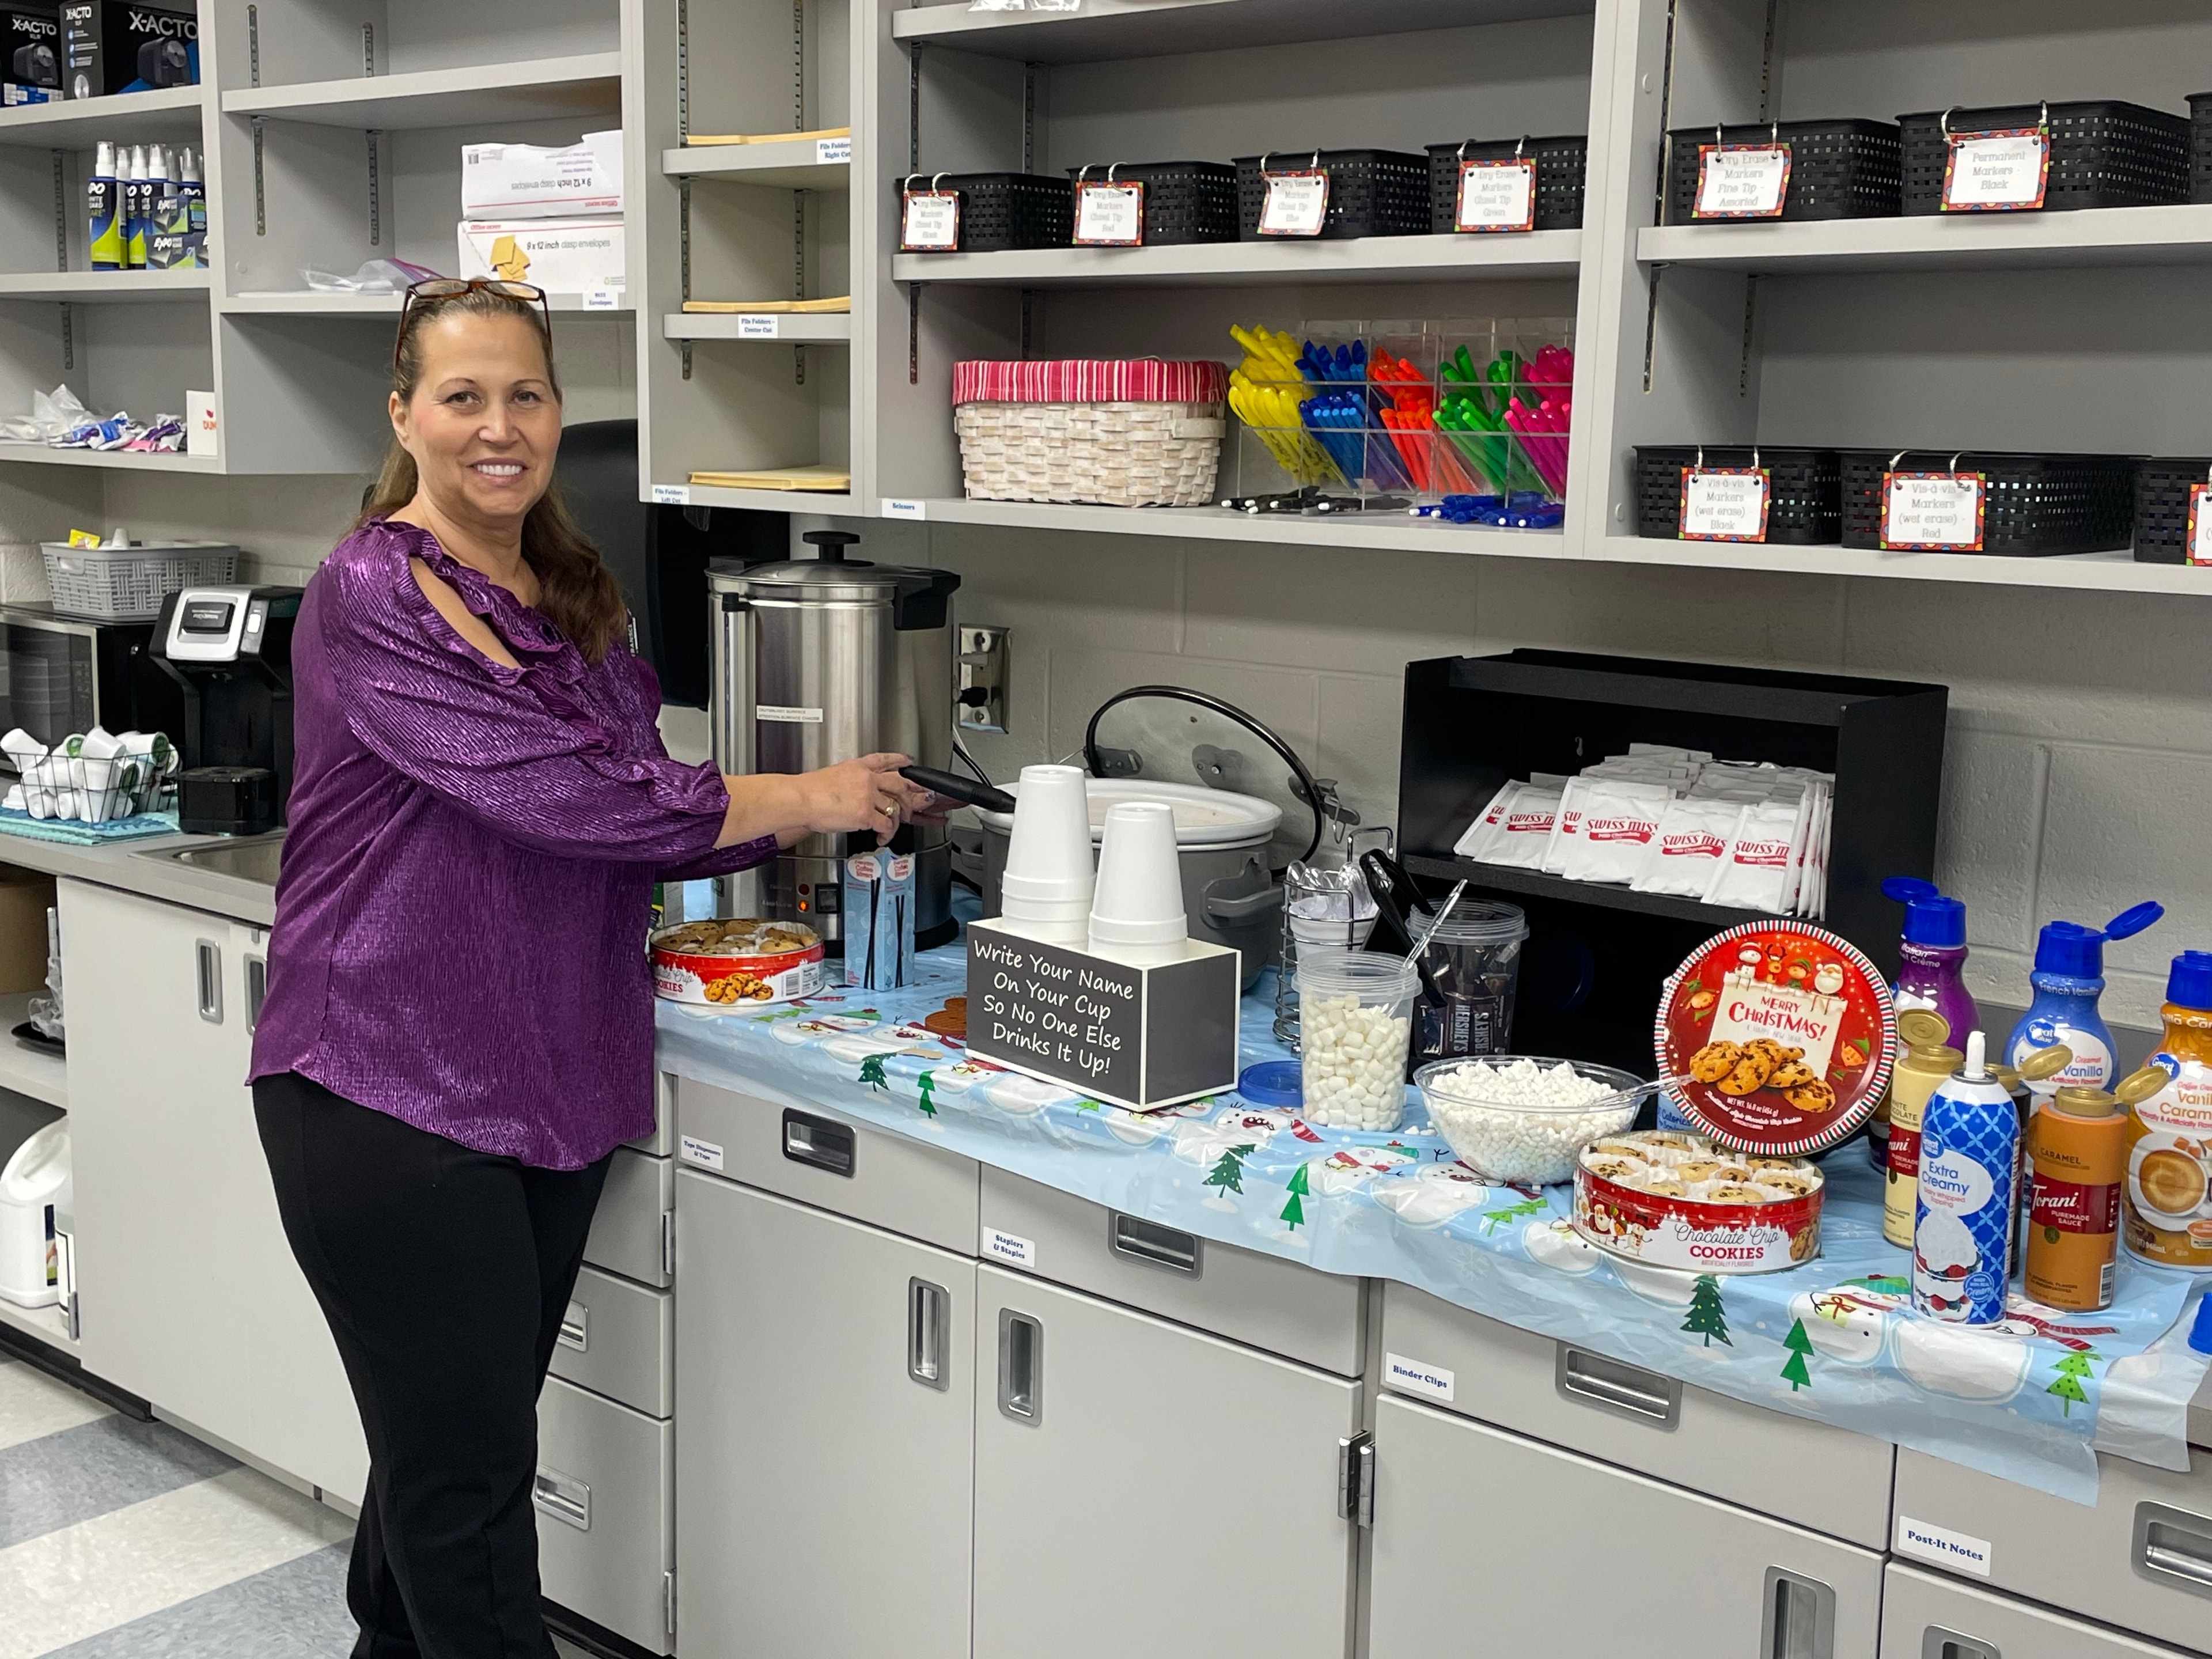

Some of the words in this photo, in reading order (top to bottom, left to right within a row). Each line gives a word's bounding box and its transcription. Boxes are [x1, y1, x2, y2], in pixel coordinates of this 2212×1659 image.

[66, 6, 92, 20] X-ACTO
[12, 18, 56, 35] X-ACTO
[128, 12, 198, 39] X-ACTO
[1721, 156, 1738, 165] Dry
[1743, 154, 1768, 164] Erase
[1972, 151, 2025, 162] Permanent
[1479, 171, 1493, 180] Dry
[1496, 171, 1516, 179] Erase
[1725, 169, 1763, 179] Markers
[1972, 166, 2013, 176] Markers
[557, 180, 573, 188] inch
[1481, 183, 1512, 192] Markers
[1718, 184, 1738, 193] Fine
[1743, 183, 1756, 194] Tip
[1980, 180, 2009, 190] Black
[1499, 196, 1511, 206] Tip
[1719, 196, 1759, 207] Assorted
[544, 241, 559, 249] inch
[578, 238, 611, 249] envelopes
[1706, 492, 1744, 502] Markers
[1911, 498, 1955, 509] Markers
[1695, 506, 1714, 517] (wet
[1717, 506, 1745, 518] erase)
[1710, 520, 1736, 530] Black
[1899, 513, 1920, 525] (wet
[1925, 514, 1957, 525] erase)
[1922, 528, 1941, 539] Red
[1505, 813, 1543, 824] SWISS
[1585, 819, 1626, 831] SWISS
[1659, 835, 1698, 846] SWISS
[1733, 840, 1772, 854] SWISS
[974, 940, 1023, 968] Write
[1029, 953, 1073, 981] Your
[1079, 969, 1134, 999] Name
[656, 979, 683, 993] OOKIES
[2073, 987, 2099, 996] Vanilla
[994, 972, 1020, 994] On
[1026, 979, 1069, 1007] Your
[1075, 995, 1111, 1026] Cup
[1760, 996, 1802, 1013] MERRY
[983, 995, 1005, 1015] So
[1012, 1003, 1035, 1024] No
[1042, 1012, 1078, 1037] One
[1086, 1025, 1122, 1051] Else
[1454, 1005, 1470, 1052] HERSHEY'S
[1475, 1013, 1489, 1055] ERSHEY'S
[993, 1022, 1051, 1056] Drinks
[1058, 1043, 1071, 1062] It
[1079, 1052, 1111, 1077] Up!
[2064, 1066, 2103, 1077] Vanilla
[2040, 1147, 2081, 1164] CARAMEL
[1929, 1160, 1959, 1179] Extra
[1922, 1170, 1970, 1196] Creamy
[2032, 1184, 2079, 1211] Torani
[2051, 1210, 2090, 1222] PUREMADE
[2058, 1218, 2082, 1226] SAUCE
[995, 1234, 1023, 1249] Staplers
[1675, 1224, 1745, 1244] Chocolate
[1750, 1228, 1780, 1248] Chip
[1001, 1245, 1025, 1259] Staples
[1690, 1245, 1764, 1259] COOKIES
[1393, 1365, 1422, 1380] Binder
[1425, 1375, 1447, 1388] Clips
[1908, 1530, 1946, 1550] Post-It
[1949, 1543, 1983, 1560] Notes
